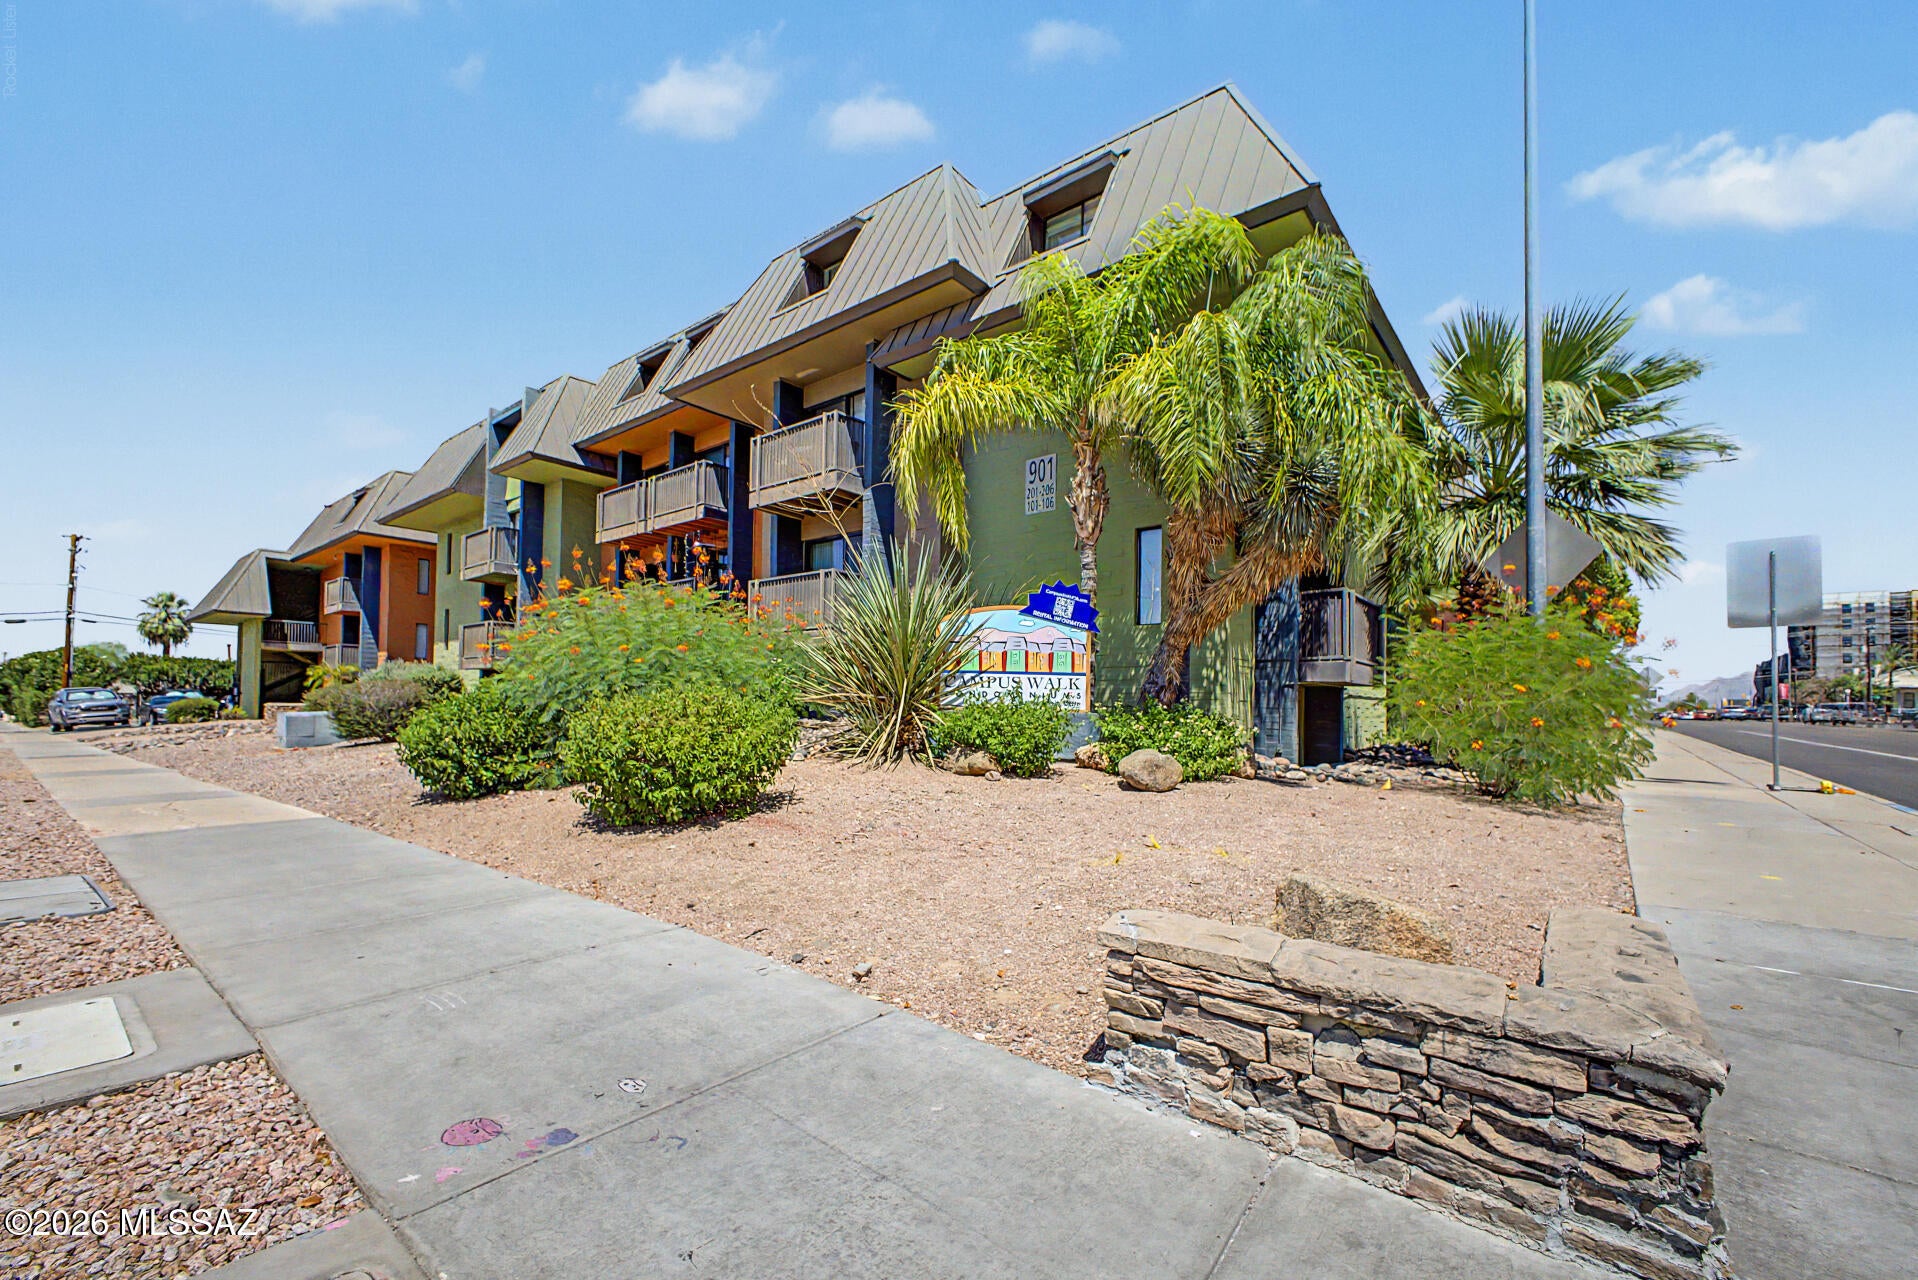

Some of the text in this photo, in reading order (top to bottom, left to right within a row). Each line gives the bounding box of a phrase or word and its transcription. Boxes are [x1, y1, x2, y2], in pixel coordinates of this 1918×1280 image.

[1029, 457, 1053, 484] 901
[1027, 484, 1055, 499] 201-206
[1027, 497, 1054, 512] 101-106
[945, 676, 1080, 690] CAMPUS WALK
